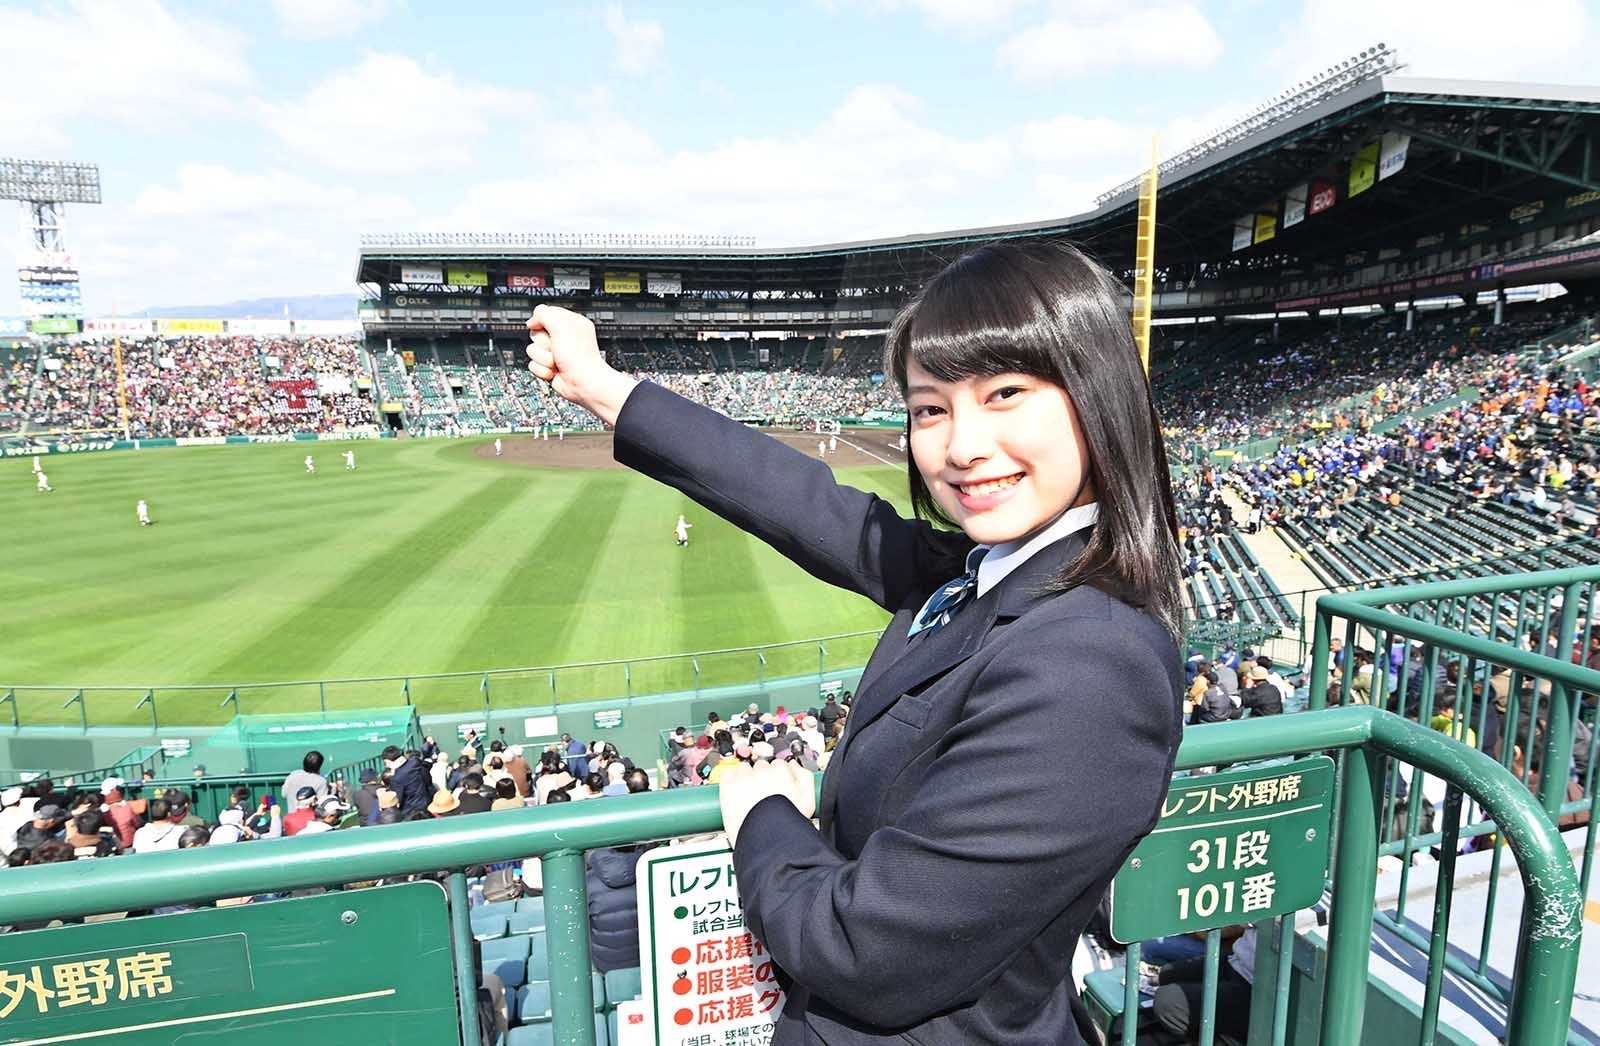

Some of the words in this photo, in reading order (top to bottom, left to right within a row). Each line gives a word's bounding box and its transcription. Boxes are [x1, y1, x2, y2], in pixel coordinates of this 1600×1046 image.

[513, 276, 540, 286] ECC
[1160, 775, 1302, 818] レフト外野席
[1187, 830, 1271, 873] 31段
[670, 864, 737, 897] 【レフト
[1177, 871, 1276, 920] 101番
[693, 896, 743, 917] レフト
[696, 932, 763, 964] 応援
[0, 952, 173, 1018] 外野席
[697, 961, 776, 995] 服装の
[698, 988, 782, 1025] 応援グ
